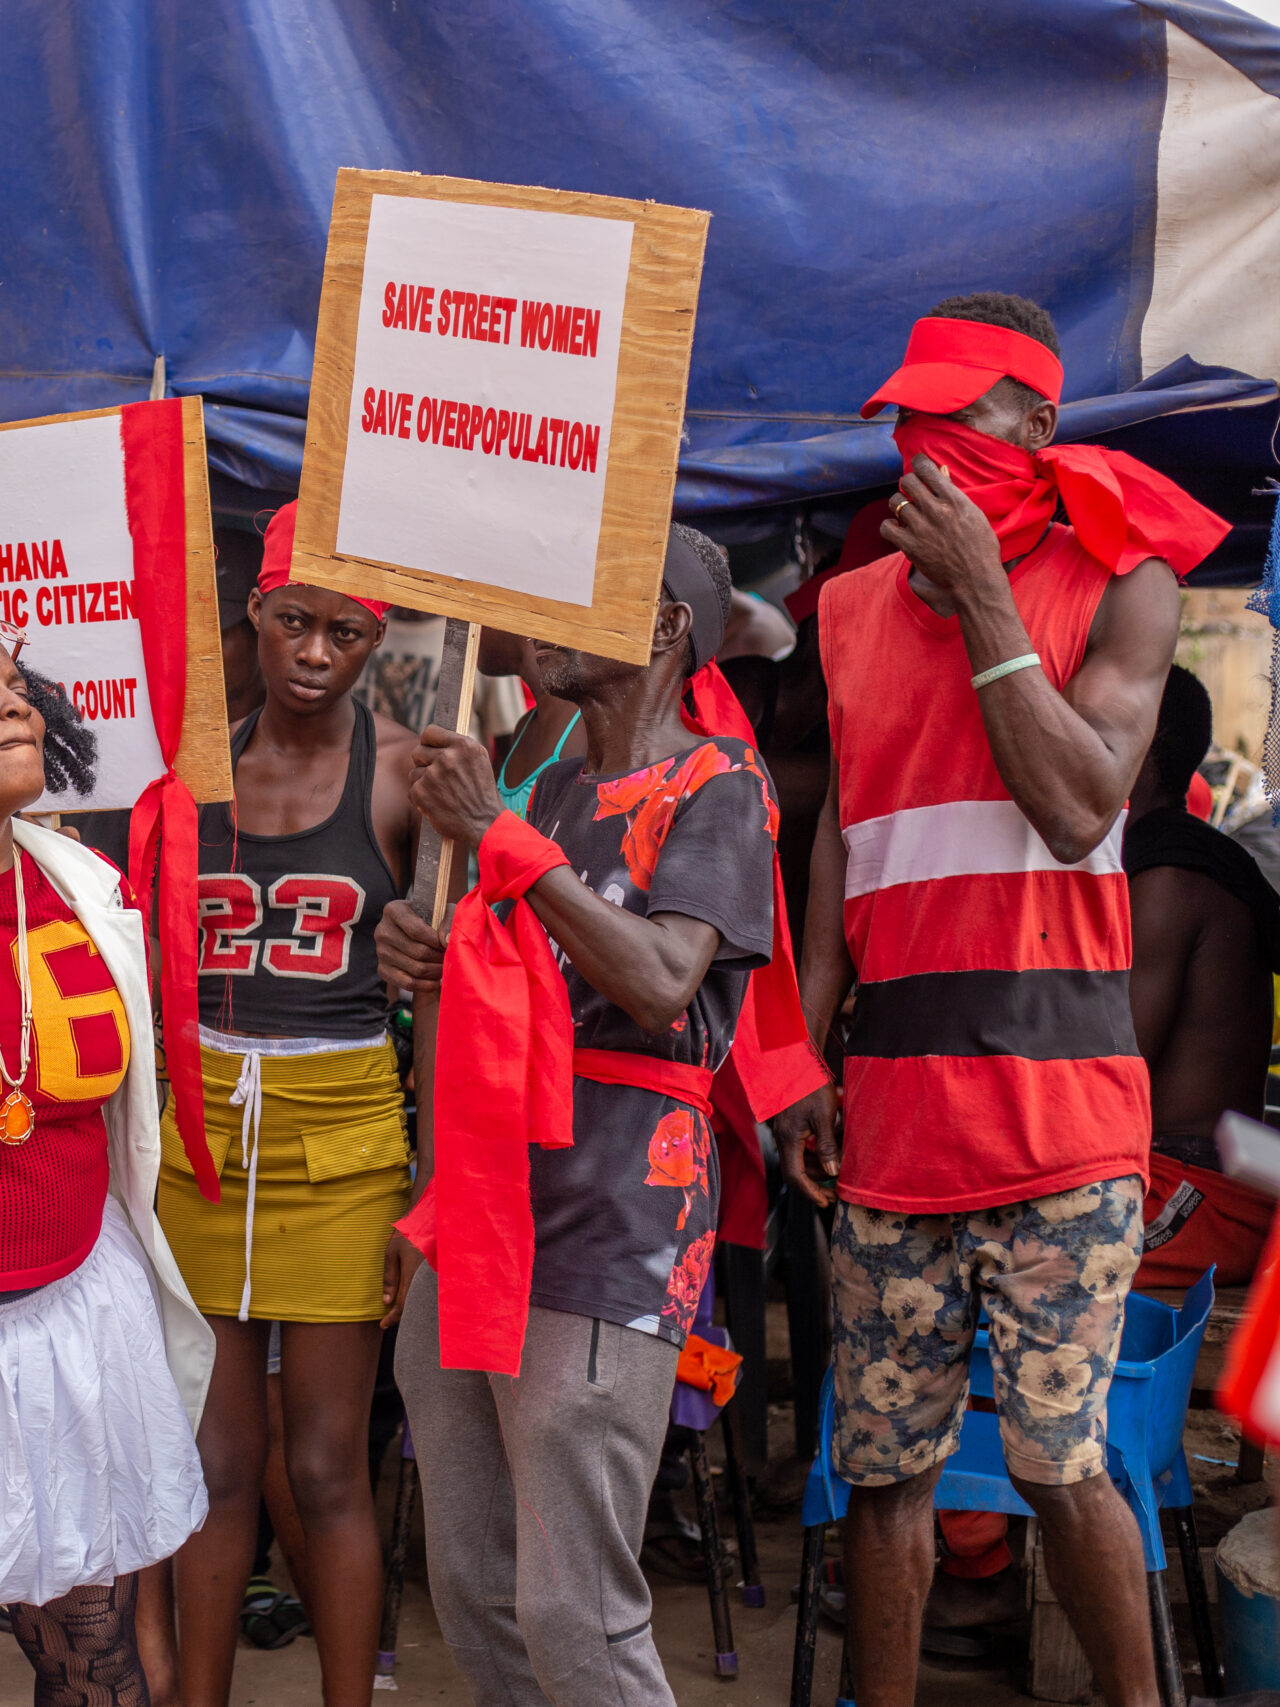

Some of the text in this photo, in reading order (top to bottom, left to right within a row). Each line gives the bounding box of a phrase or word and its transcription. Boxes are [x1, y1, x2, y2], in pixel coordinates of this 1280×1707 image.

[382, 281, 601, 358] SAVE STREET WOMEN
[361, 386, 601, 474] SAVE OVERPOPULATION
[73, 677, 137, 721] COUNT
[198, 872, 366, 982] 23
